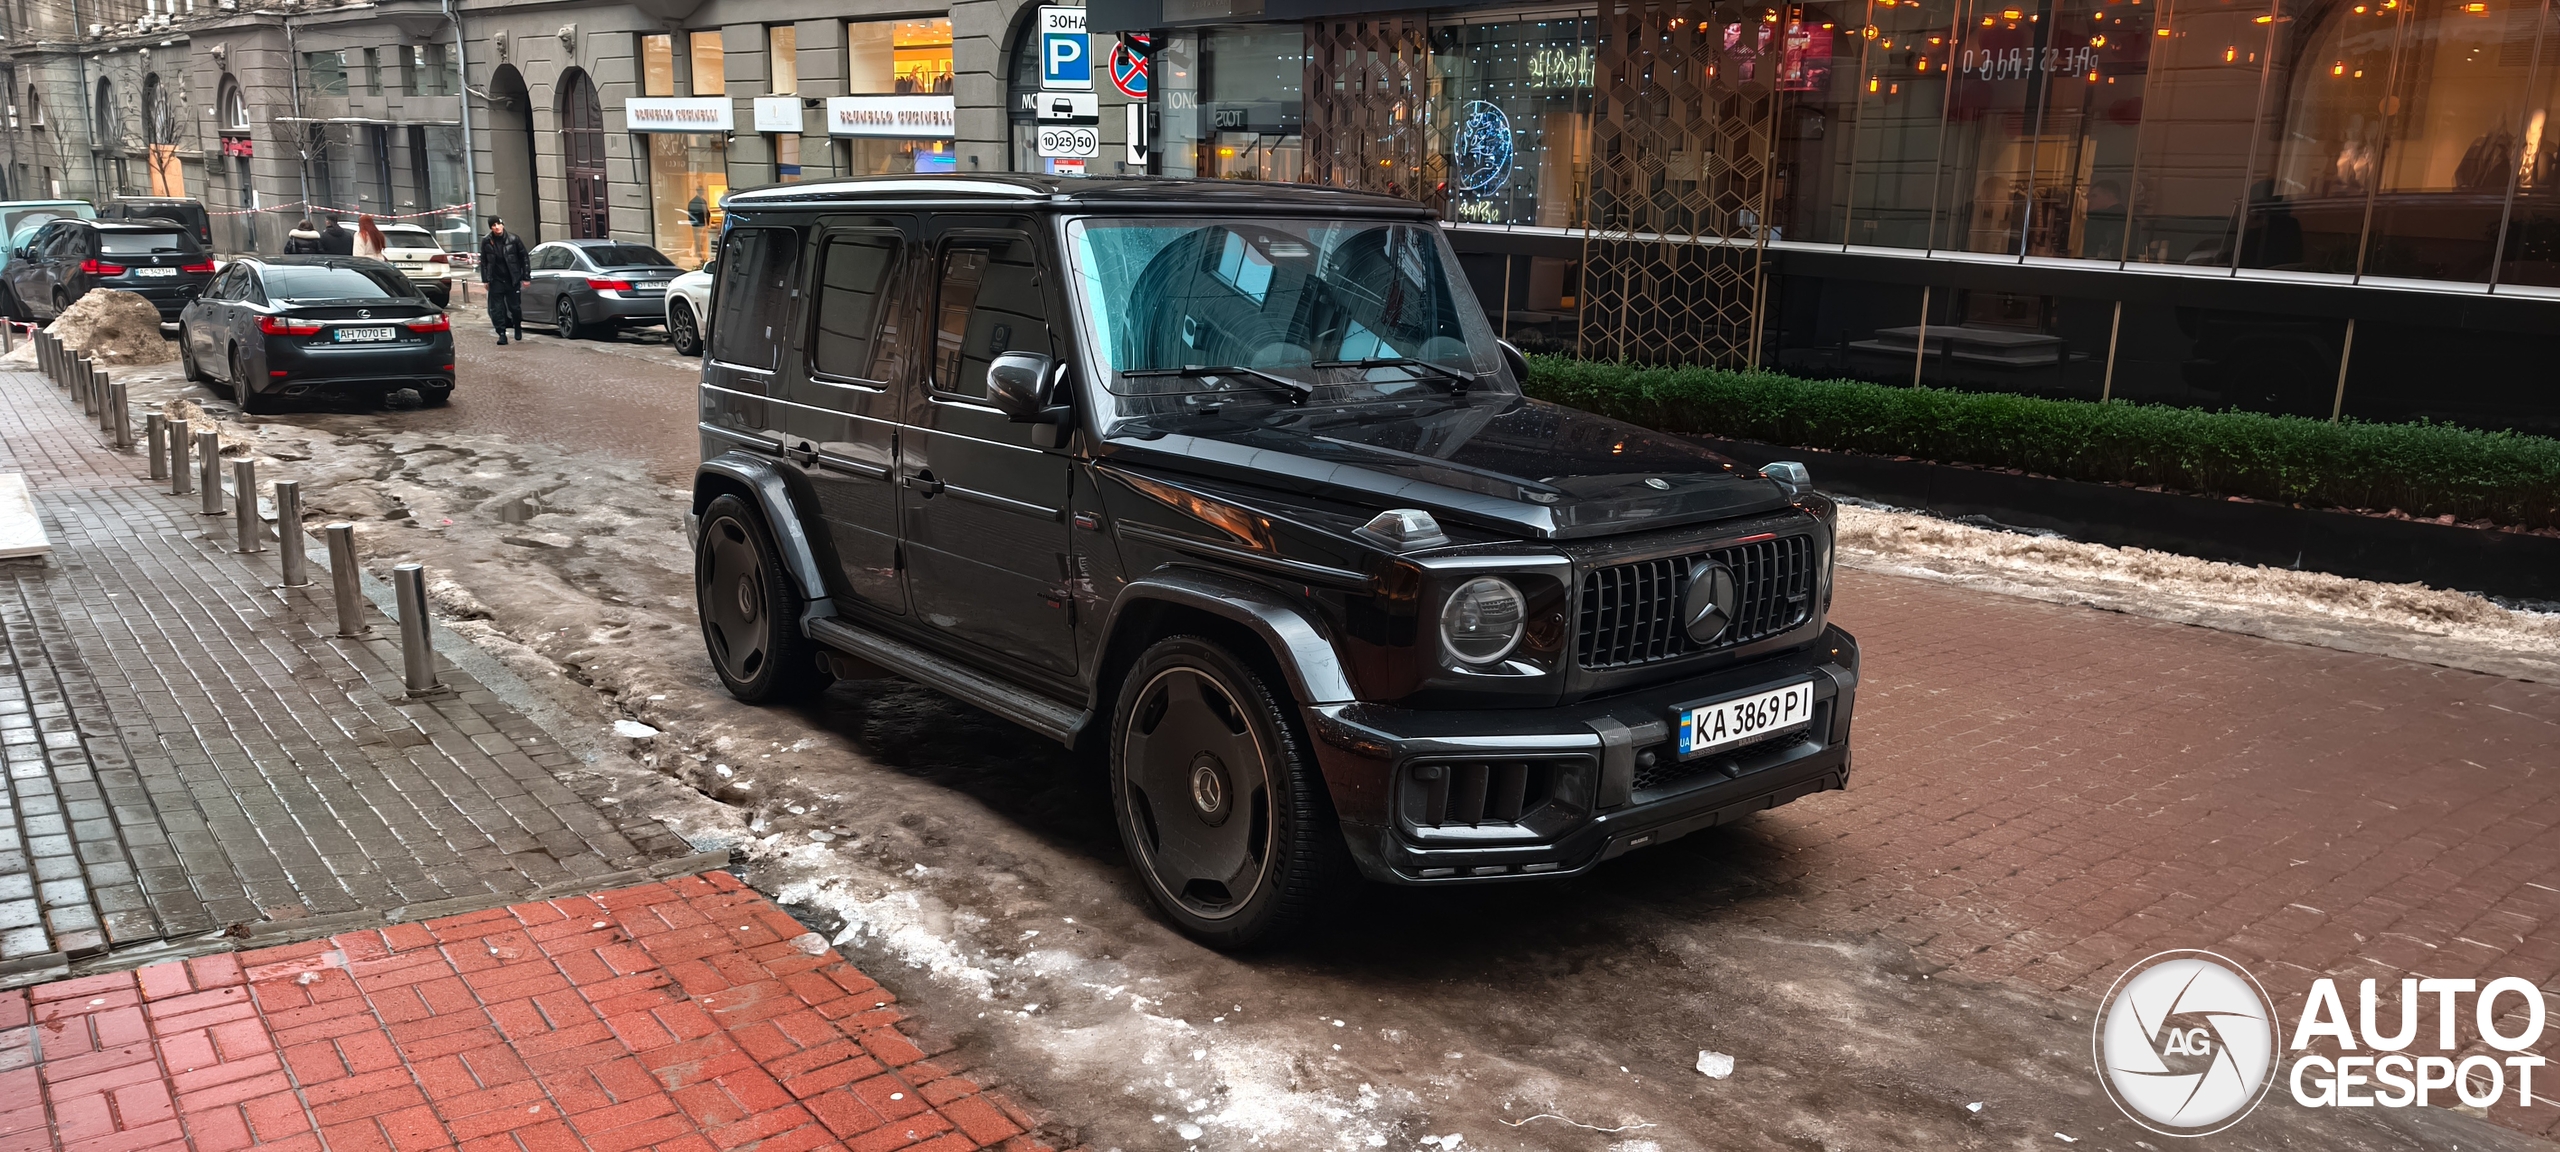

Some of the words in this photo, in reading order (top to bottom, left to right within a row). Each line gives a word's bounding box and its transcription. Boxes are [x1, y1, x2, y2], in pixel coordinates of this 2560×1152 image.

[1050, 14, 1086, 28] ЗОНА
[1049, 39, 1081, 74] P
[839, 110, 894, 125] BRUNELLO
[1043, 136, 1054, 146] 10
[1059, 136, 1072, 147] 25
[1077, 136, 1091, 148] 50
[340, 330, 355, 339] AH
[355, 329, 379, 338] 7070
[1696, 709, 1726, 745] KA
[1732, 695, 1779, 735] 3869
[1784, 687, 1808, 722] PI
[1680, 737, 1690, 748] UA
[1272, 787, 1287, 885] MICHELIN
